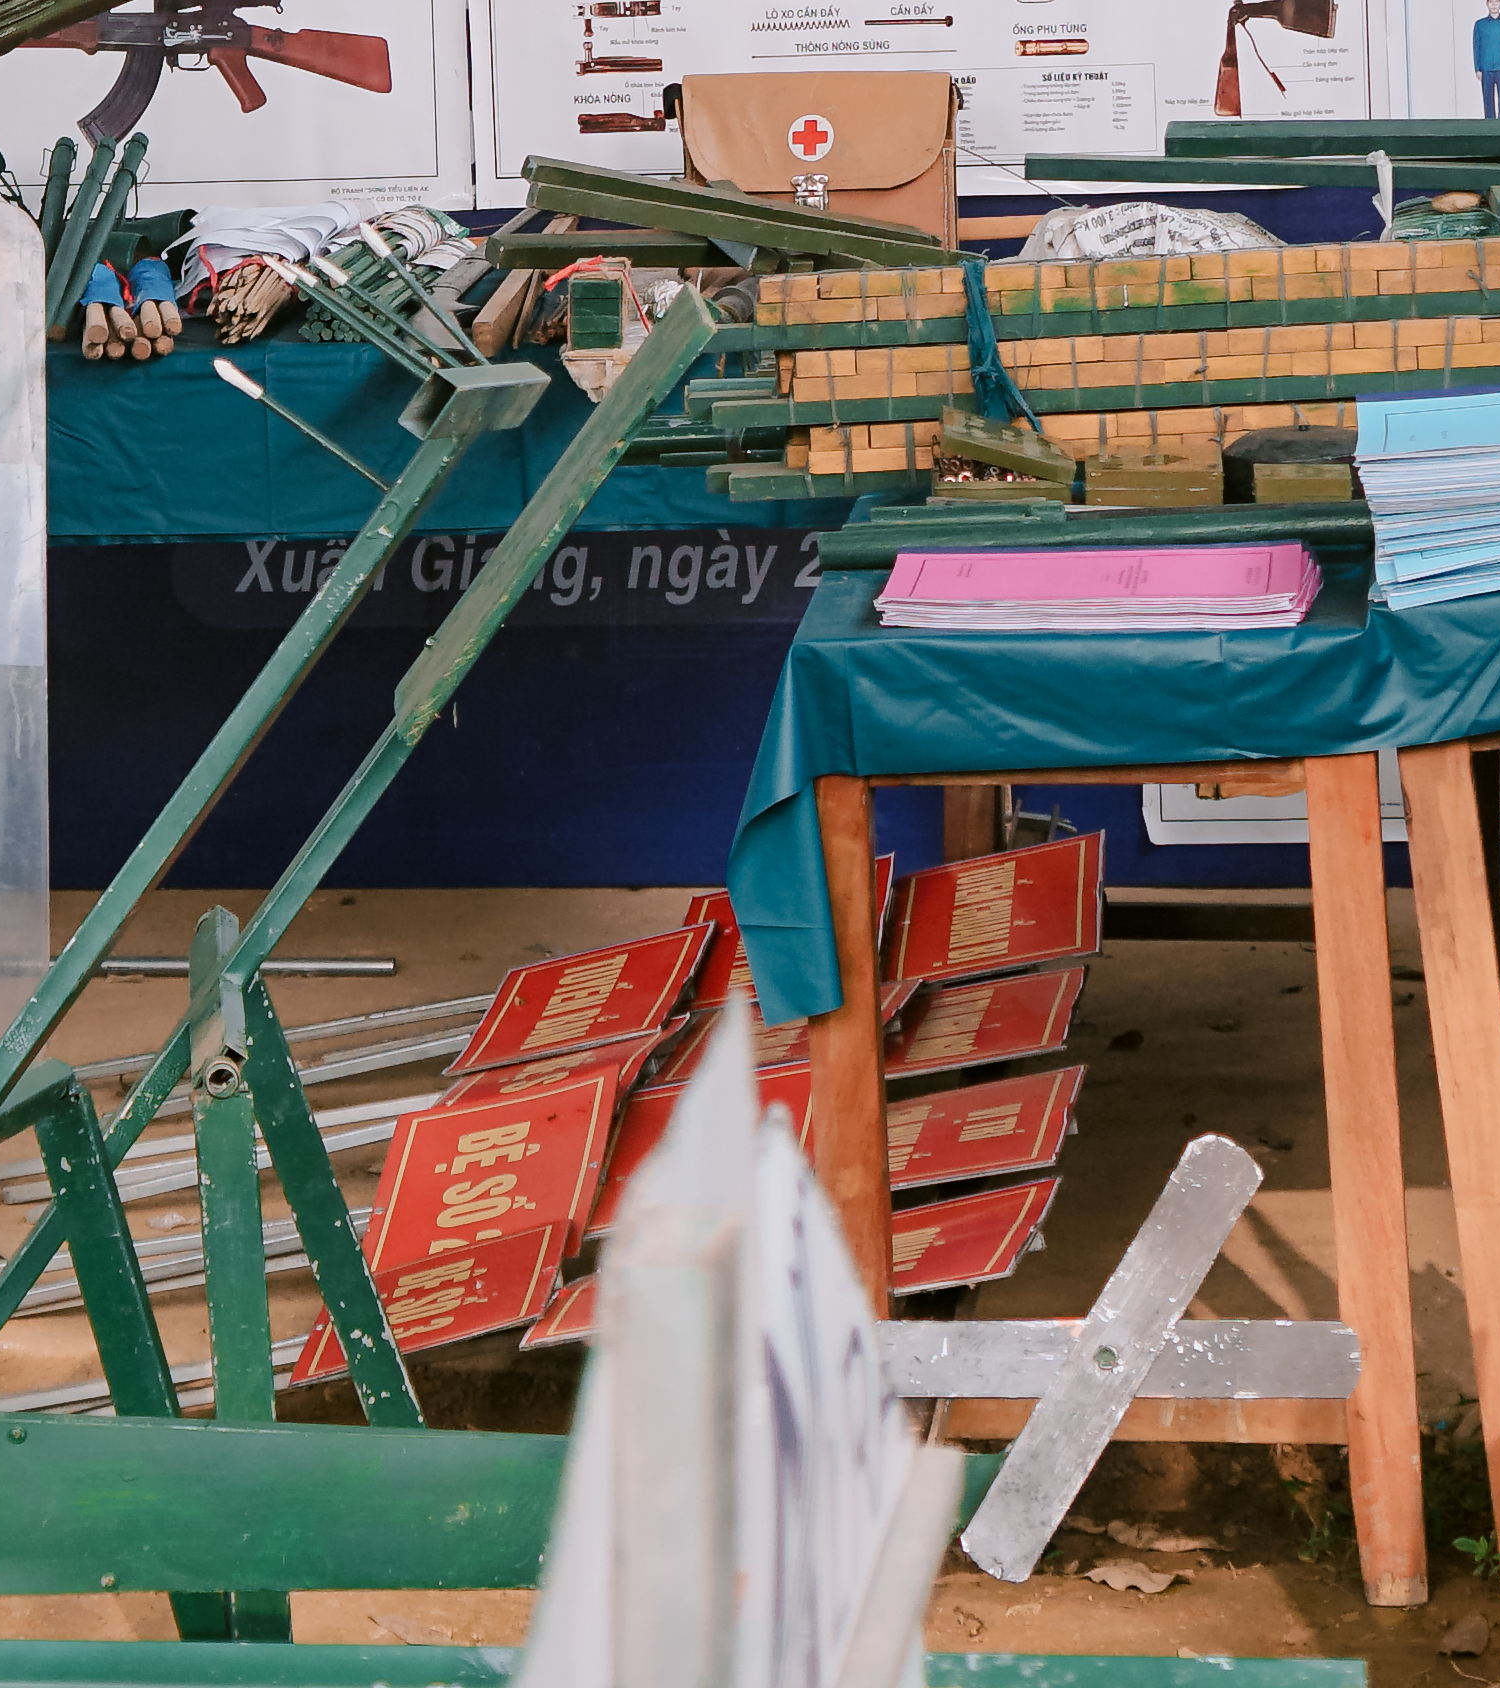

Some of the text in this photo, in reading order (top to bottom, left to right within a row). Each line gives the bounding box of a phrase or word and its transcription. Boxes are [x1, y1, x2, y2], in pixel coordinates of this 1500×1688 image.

[780, 9, 795, 19] XO
[411, 534, 602, 607] Gig,
[627, 528, 777, 606] ngày
[433, 1121, 542, 1176] BỆ
[435, 1172, 538, 1229] SỐ
[380, 1257, 489, 1300] BỆ
